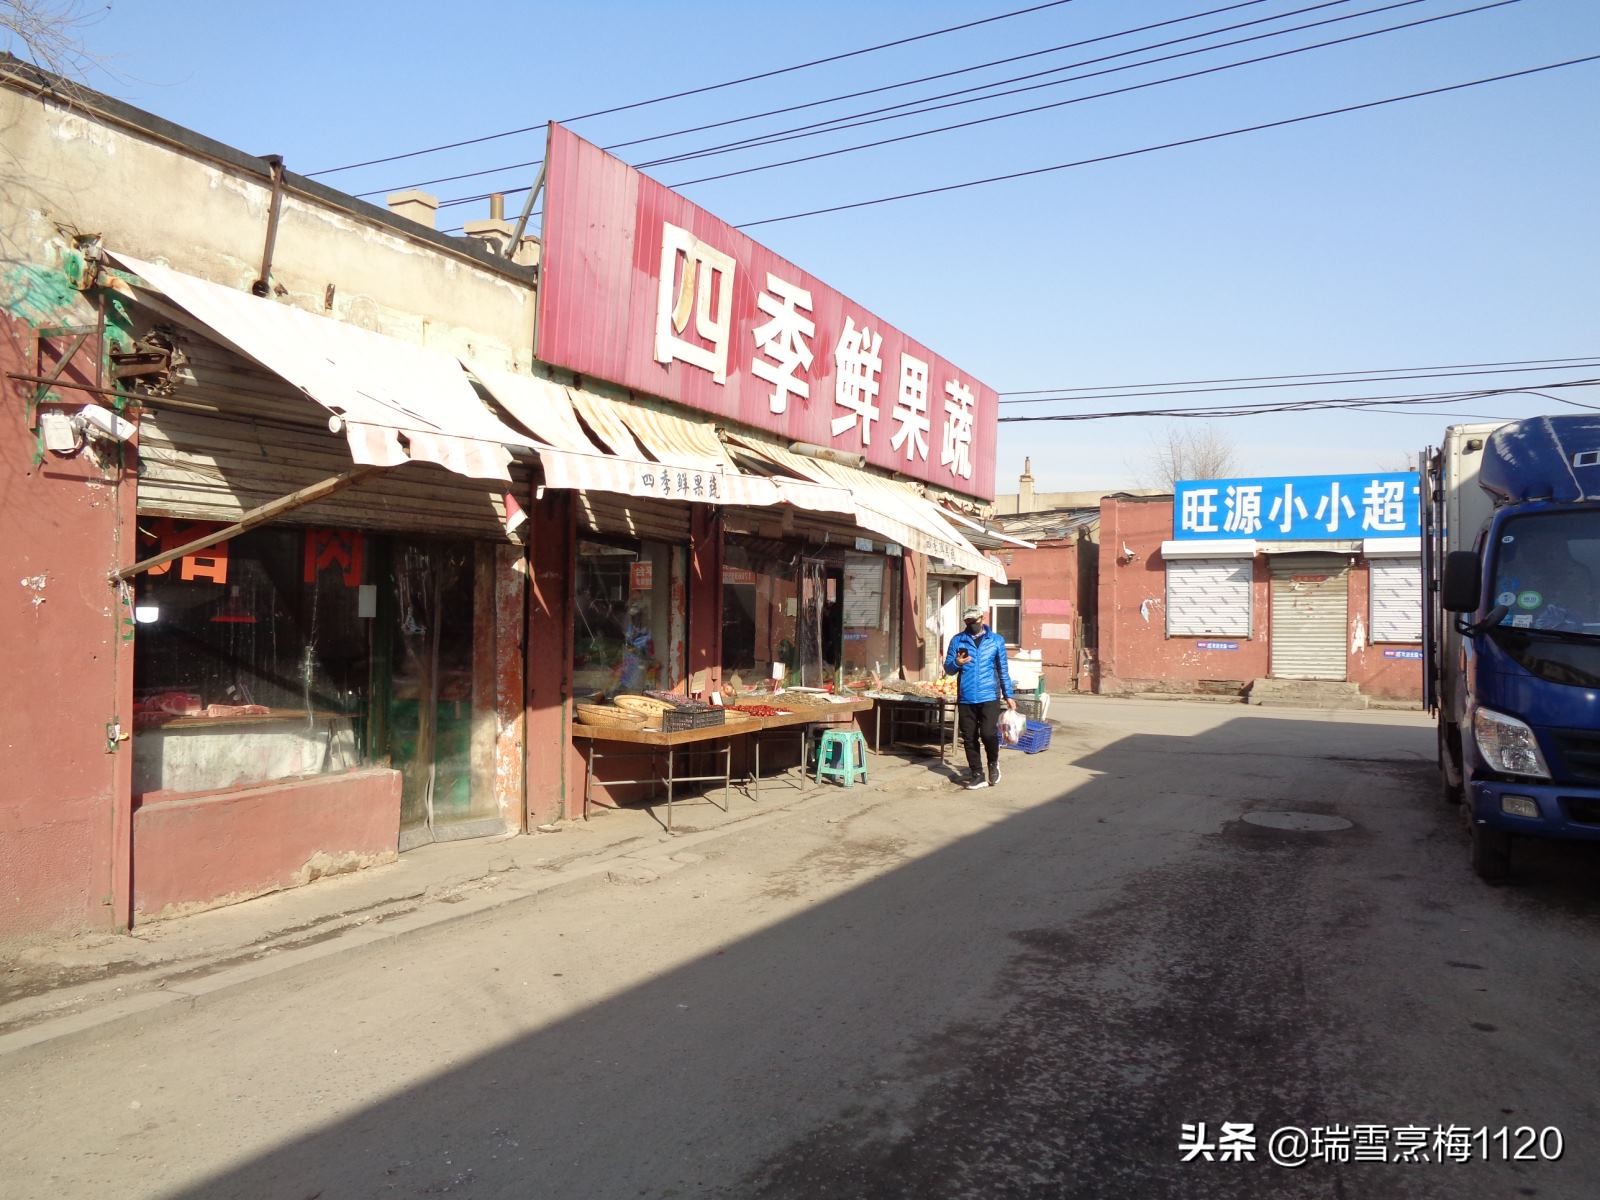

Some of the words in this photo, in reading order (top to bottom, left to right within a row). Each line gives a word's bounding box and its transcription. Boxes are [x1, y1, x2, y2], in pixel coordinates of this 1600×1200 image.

[653, 221, 975, 480] 四季鲜果蔬
[641, 468, 721, 499] 四季鲜果蔬
[1182, 479, 1421, 535] 旺源小小超
